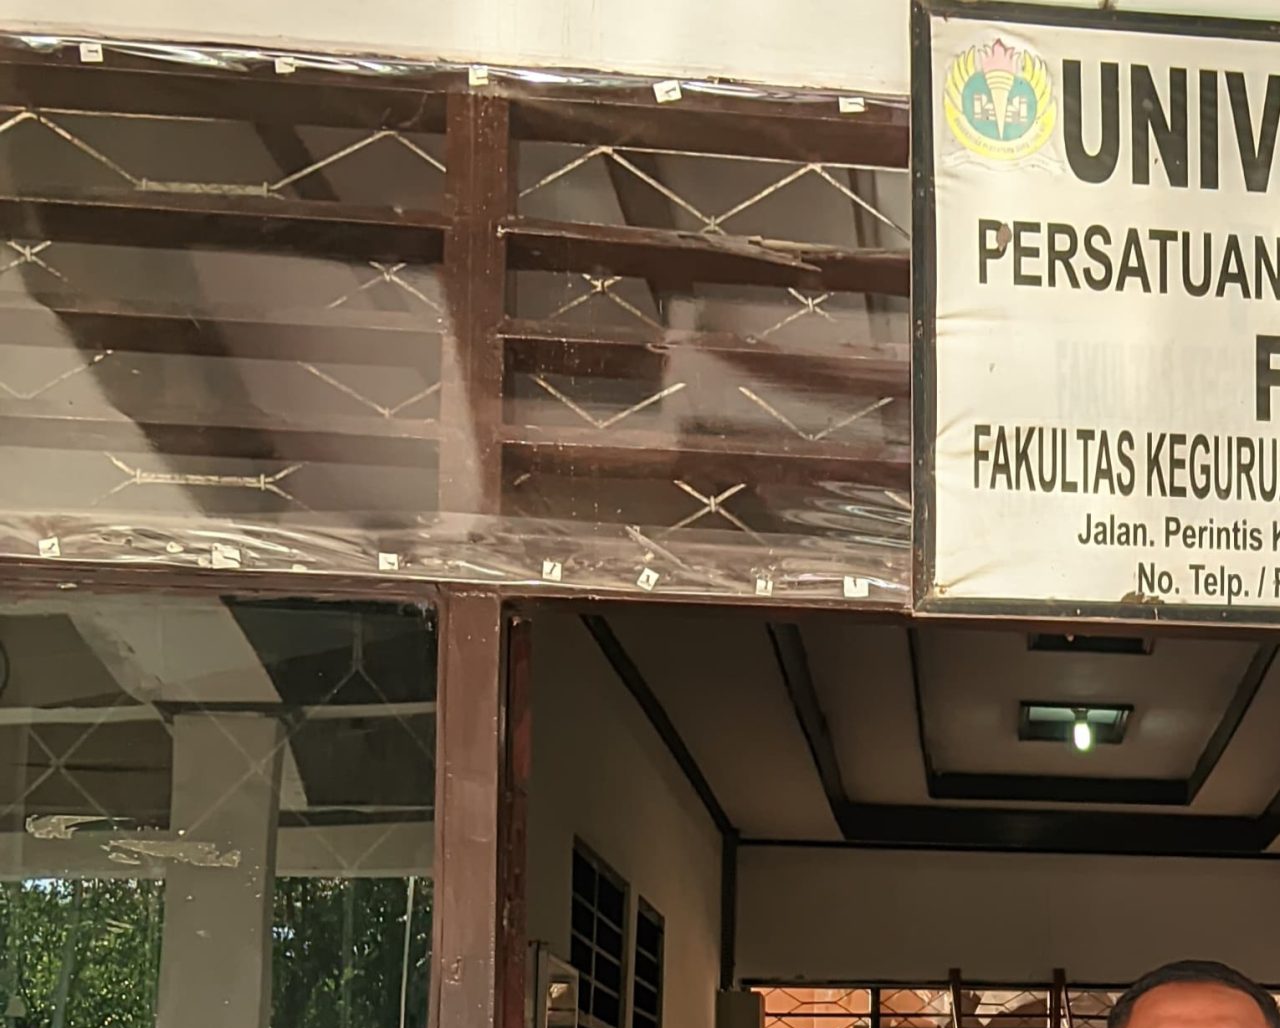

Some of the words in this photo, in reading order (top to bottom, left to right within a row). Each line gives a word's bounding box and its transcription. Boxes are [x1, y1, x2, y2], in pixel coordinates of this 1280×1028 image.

[973, 424, 1135, 496] FAKULTAS
[1077, 513, 1155, 547] Jalan.
[1165, 516, 1263, 551] Perintis
[1138, 562, 1180, 595] No.
[1189, 564, 1249, 605] Telp.
